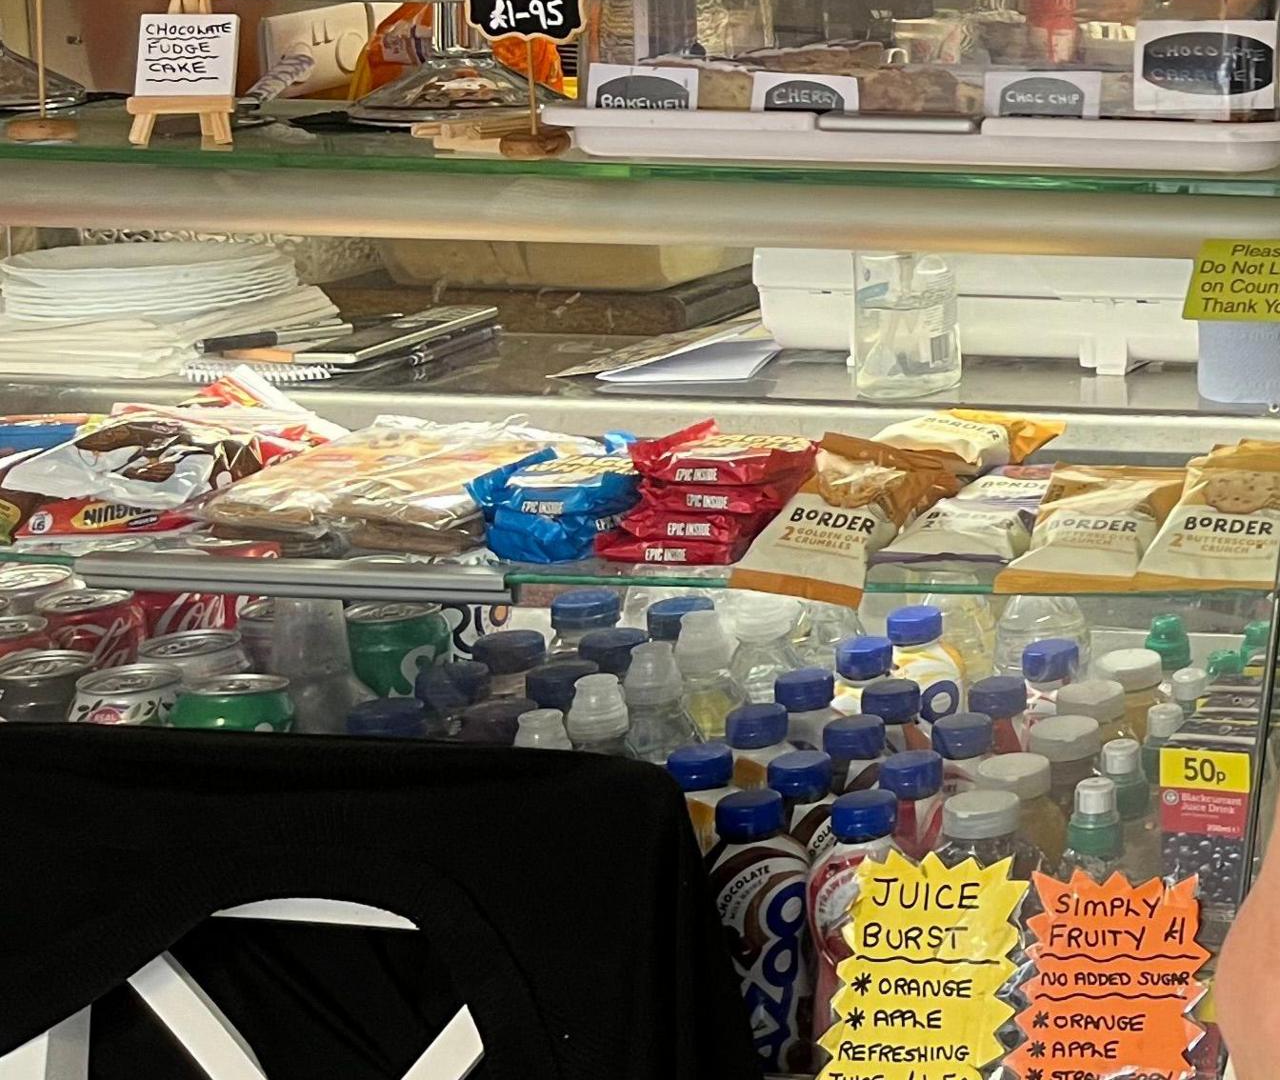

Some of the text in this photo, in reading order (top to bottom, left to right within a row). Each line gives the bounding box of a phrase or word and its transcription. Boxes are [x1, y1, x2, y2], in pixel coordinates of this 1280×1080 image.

[146, 22, 232, 36] CHOCOLATE
[147, 40, 211, 54] FUDGE
[149, 61, 207, 73] CAKE
[772, 88, 838, 108] CHERRY
[1005, 90, 1081, 105] CHOC CHIP
[1201, 260, 1226, 274] Do
[1232, 261, 1264, 275] Not
[1201, 281, 1224, 293] on
[1202, 297, 1258, 313] Thank
[674, 468, 693, 481] EPIC
[790, 506, 876, 535] BORDER
[1184, 516, 1274, 536] BORDER
[667, 522, 685, 536] EPIC
[779, 525, 867, 544] 2 GOLDEN OAT
[795, 536, 851, 551] CRUMBLES
[1168, 534, 1278, 549] 2 BUTTERSCOTCH
[1201, 545, 1249, 554] CRUNCH
[645, 548, 664, 562] EPIC
[1184, 757, 1226, 785] 50p
[1182, 792, 1242, 806] Blackcurrant
[1182, 802, 1236, 815] Juice Drink
[872, 877, 980, 911] JUICE
[1055, 894, 1161, 918] SIMPLY
[863, 922, 968, 950] BURST
[1050, 917, 1185, 950] FRUITY £1
[1041, 971, 1190, 987] NO ADDED SUGAR
[878, 977, 972, 998] ORANGE
[873, 1009, 942, 1029] APPLE
[1053, 1013, 1146, 1032] ORANGE
[838, 1040, 970, 1063] REFRESHING
[1051, 1040, 1119, 1059] APPLE
